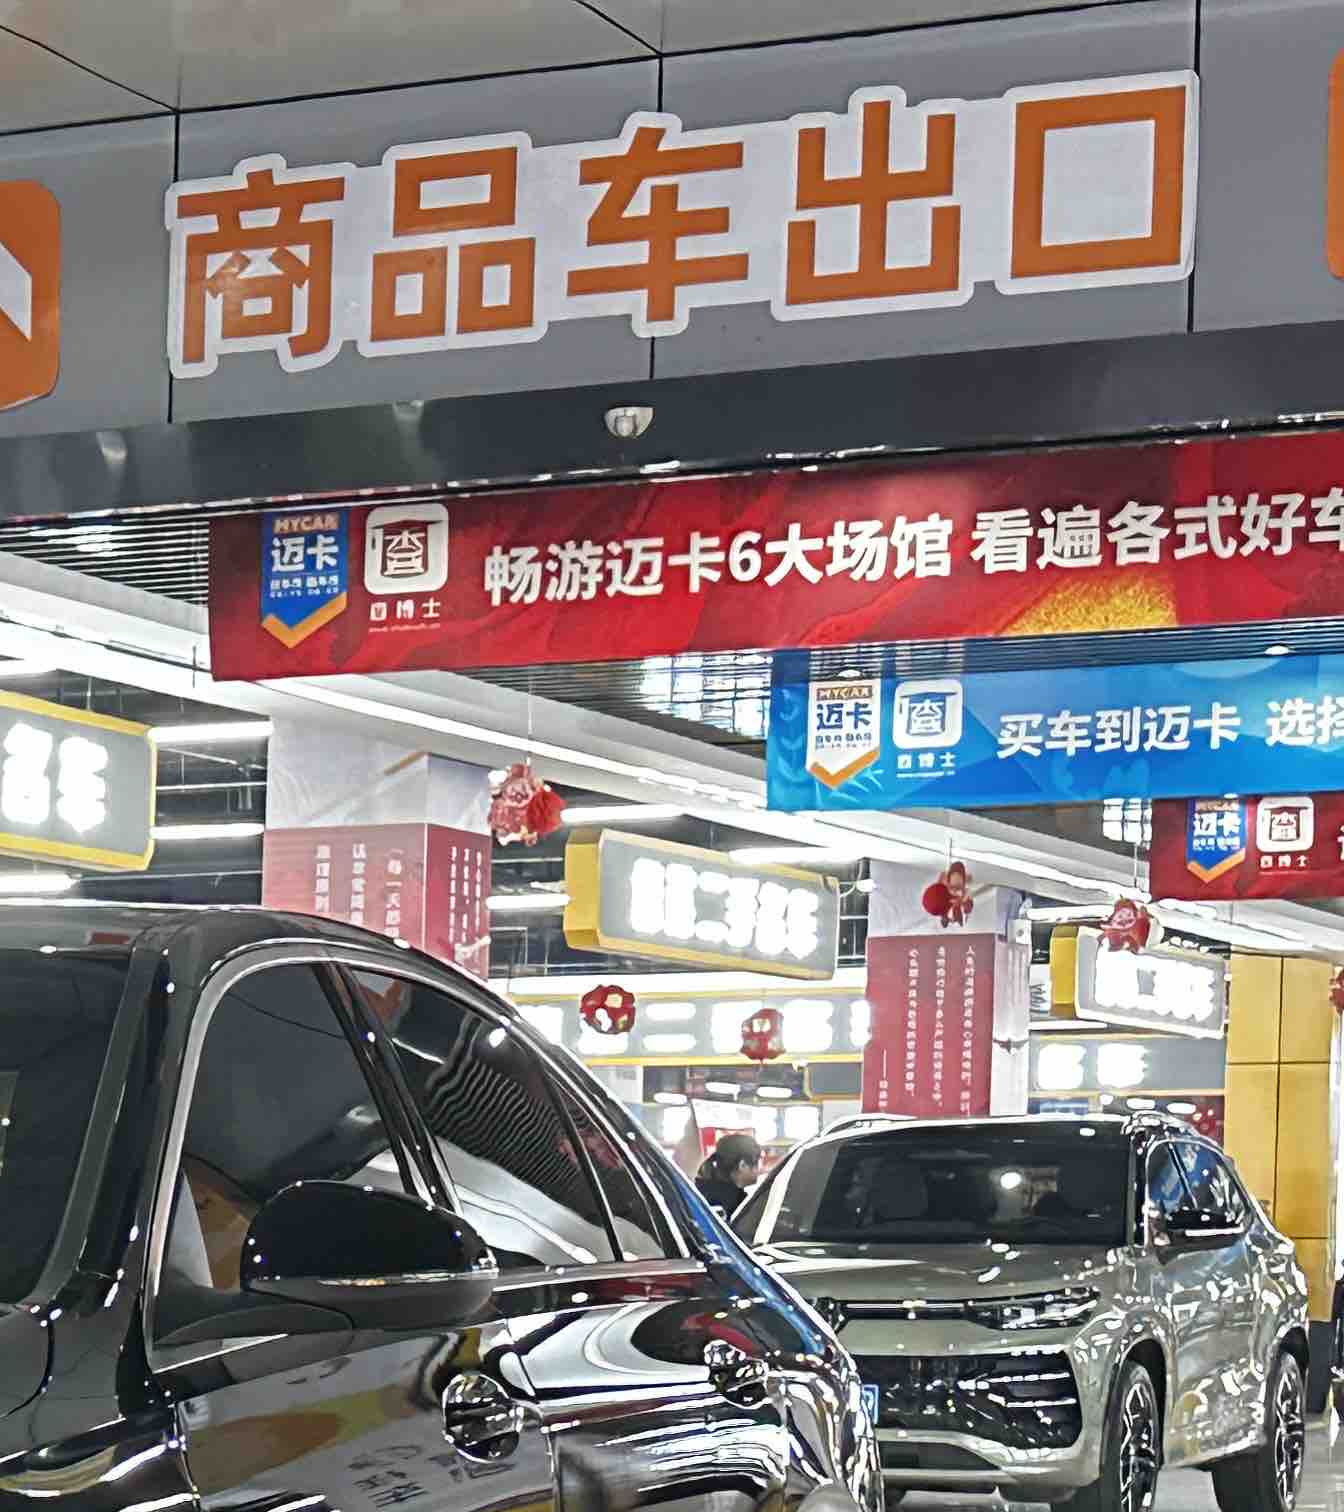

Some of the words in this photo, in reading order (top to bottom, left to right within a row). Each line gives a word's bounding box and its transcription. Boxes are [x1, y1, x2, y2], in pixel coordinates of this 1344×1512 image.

[174, 83, 1190, 366] 商品车出口
[272, 512, 340, 534] MYCAR
[270, 534, 340, 573] 迈卡
[483, 511, 954, 607] 畅游迈卡6大场馆
[368, 598, 442, 622] 查博士
[816, 701, 873, 731] 迈卡
[996, 701, 1242, 759] 买车到迈卡
